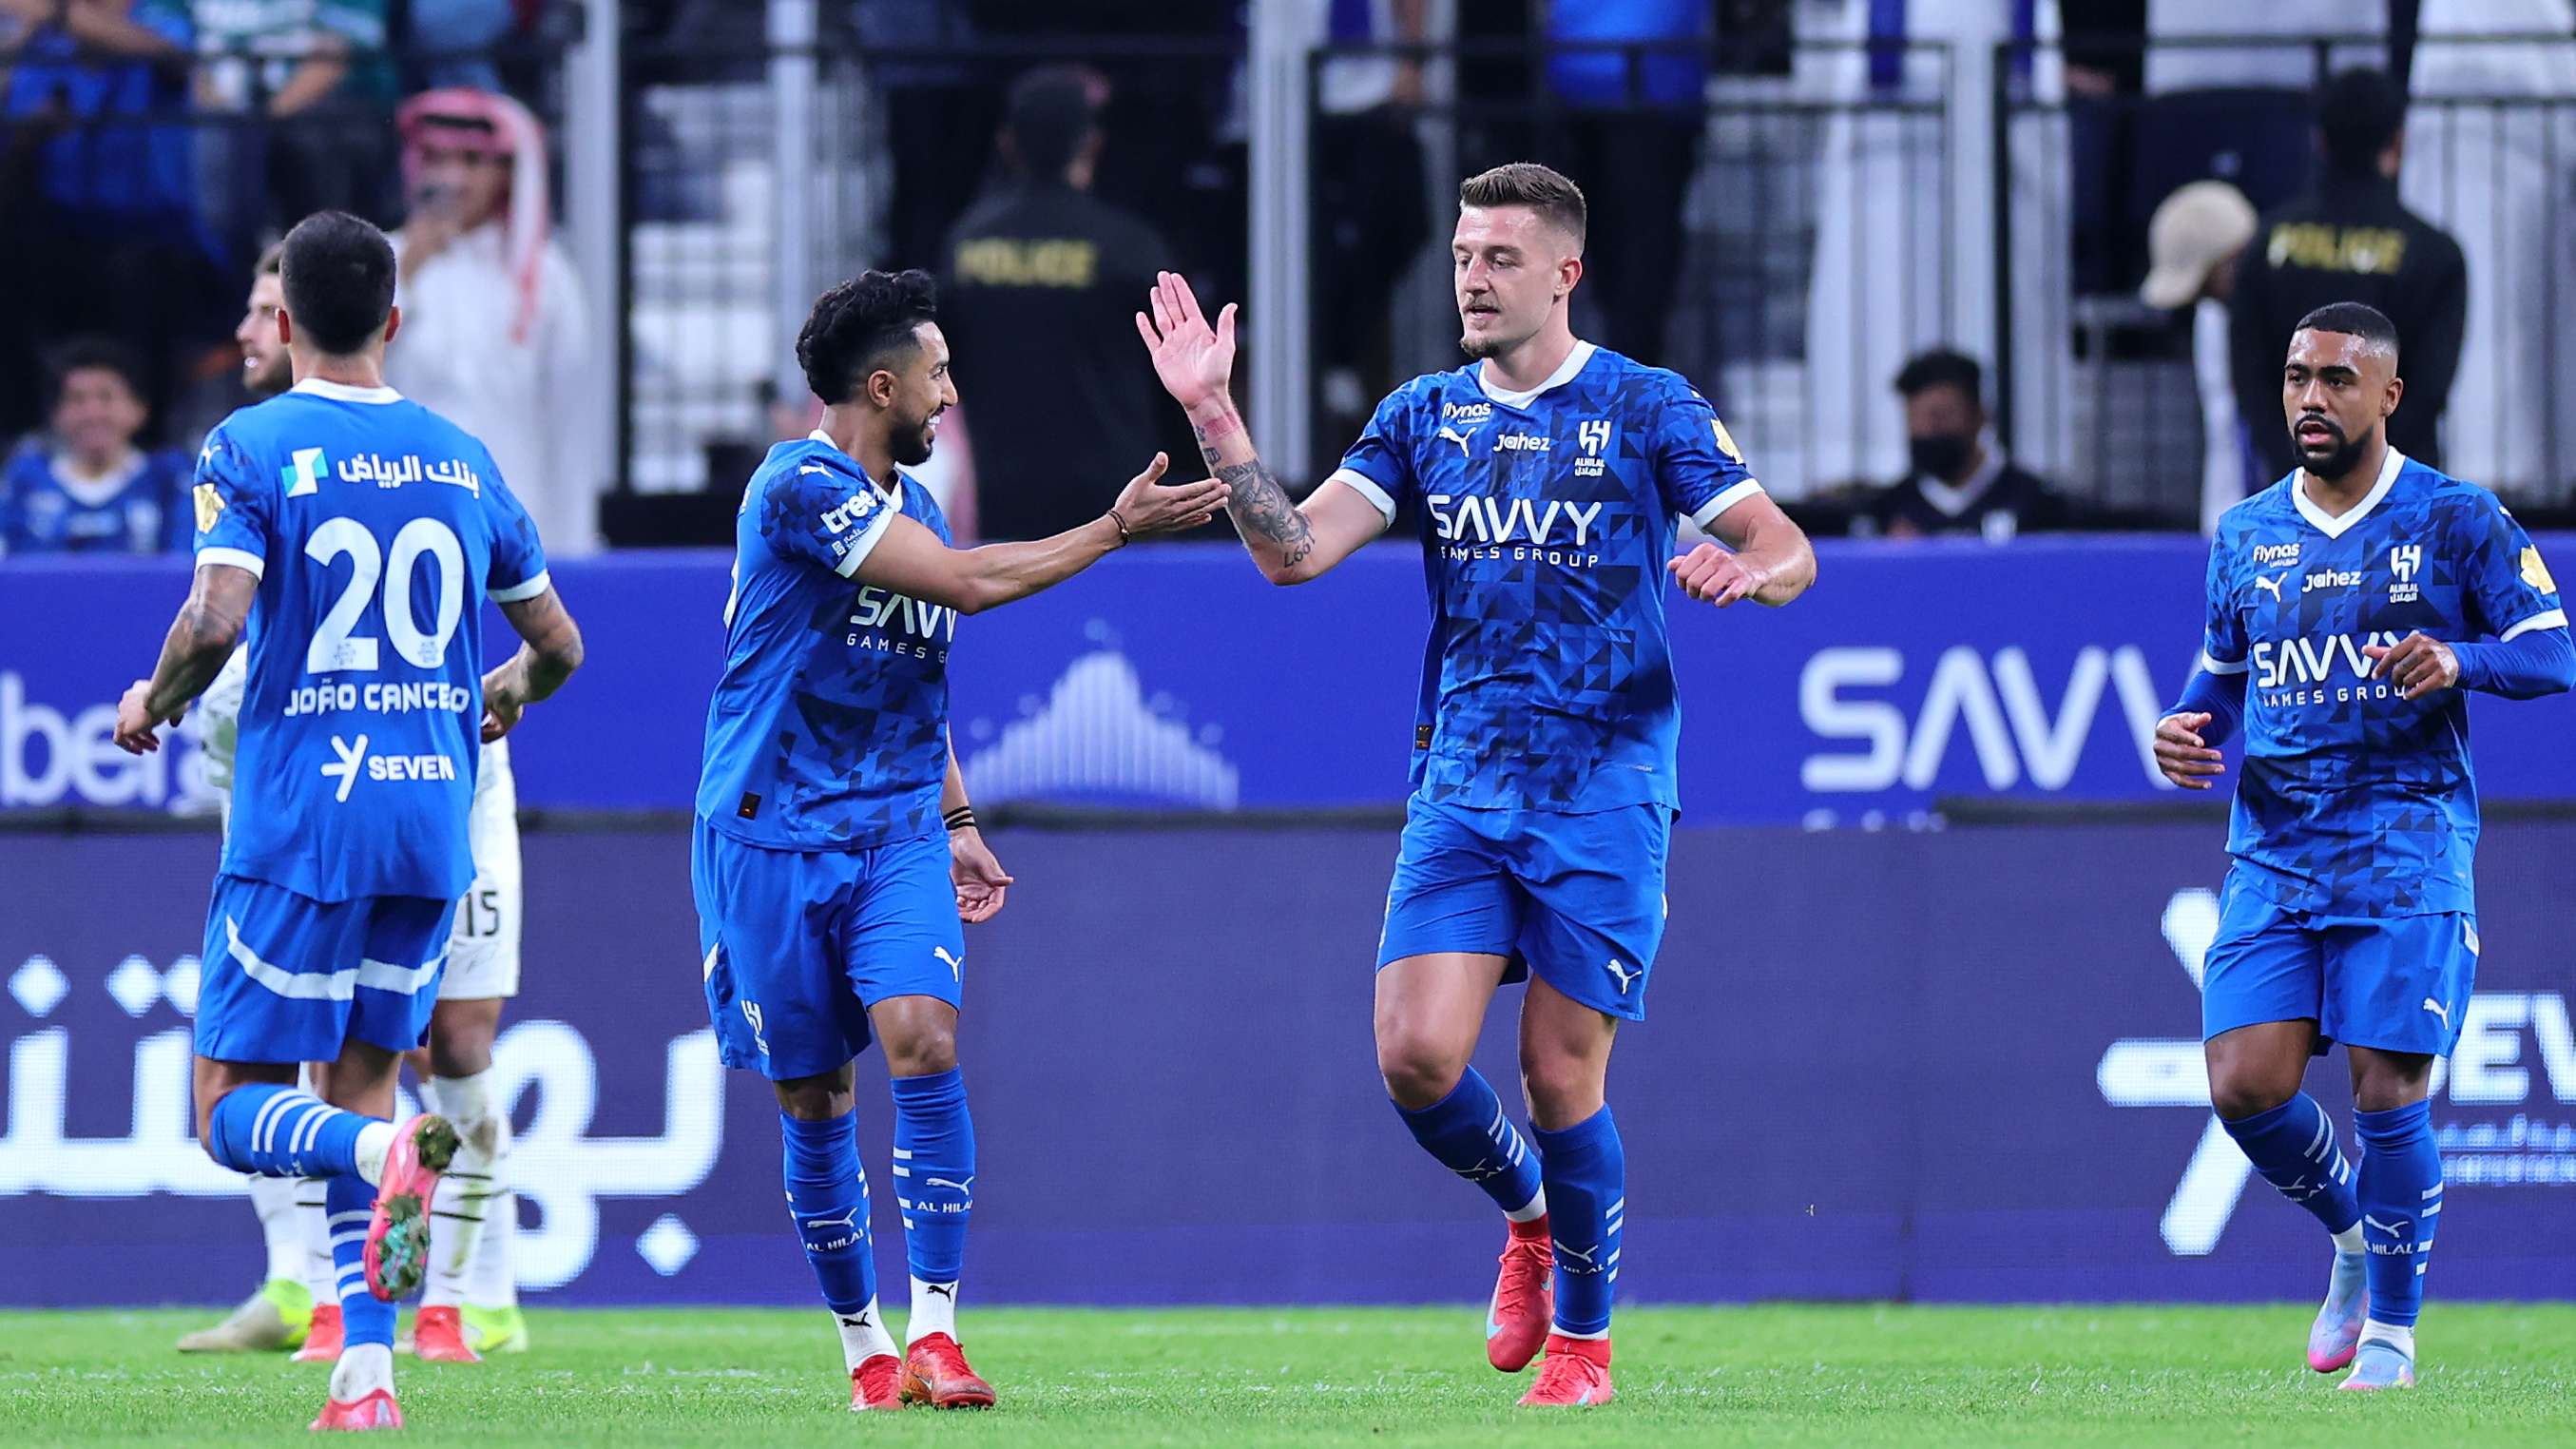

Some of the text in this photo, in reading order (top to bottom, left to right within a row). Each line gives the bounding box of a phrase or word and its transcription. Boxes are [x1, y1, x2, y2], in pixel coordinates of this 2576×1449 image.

[337, 453, 479, 499] بنك الرياض
[1427, 494, 1603, 546] SAVVY
[1513, 547, 1599, 569] GROUP
[2253, 543, 2300, 564] flynas
[304, 516, 465, 675] 20
[846, 632, 928, 659] GAMES
[284, 678, 357, 717] JOÃO
[2336, 684, 2420, 702] GROU
[368, 755, 456, 781] SEVEN
[466, 890, 501, 937] 15
[917, 1201, 938, 1212] AL
